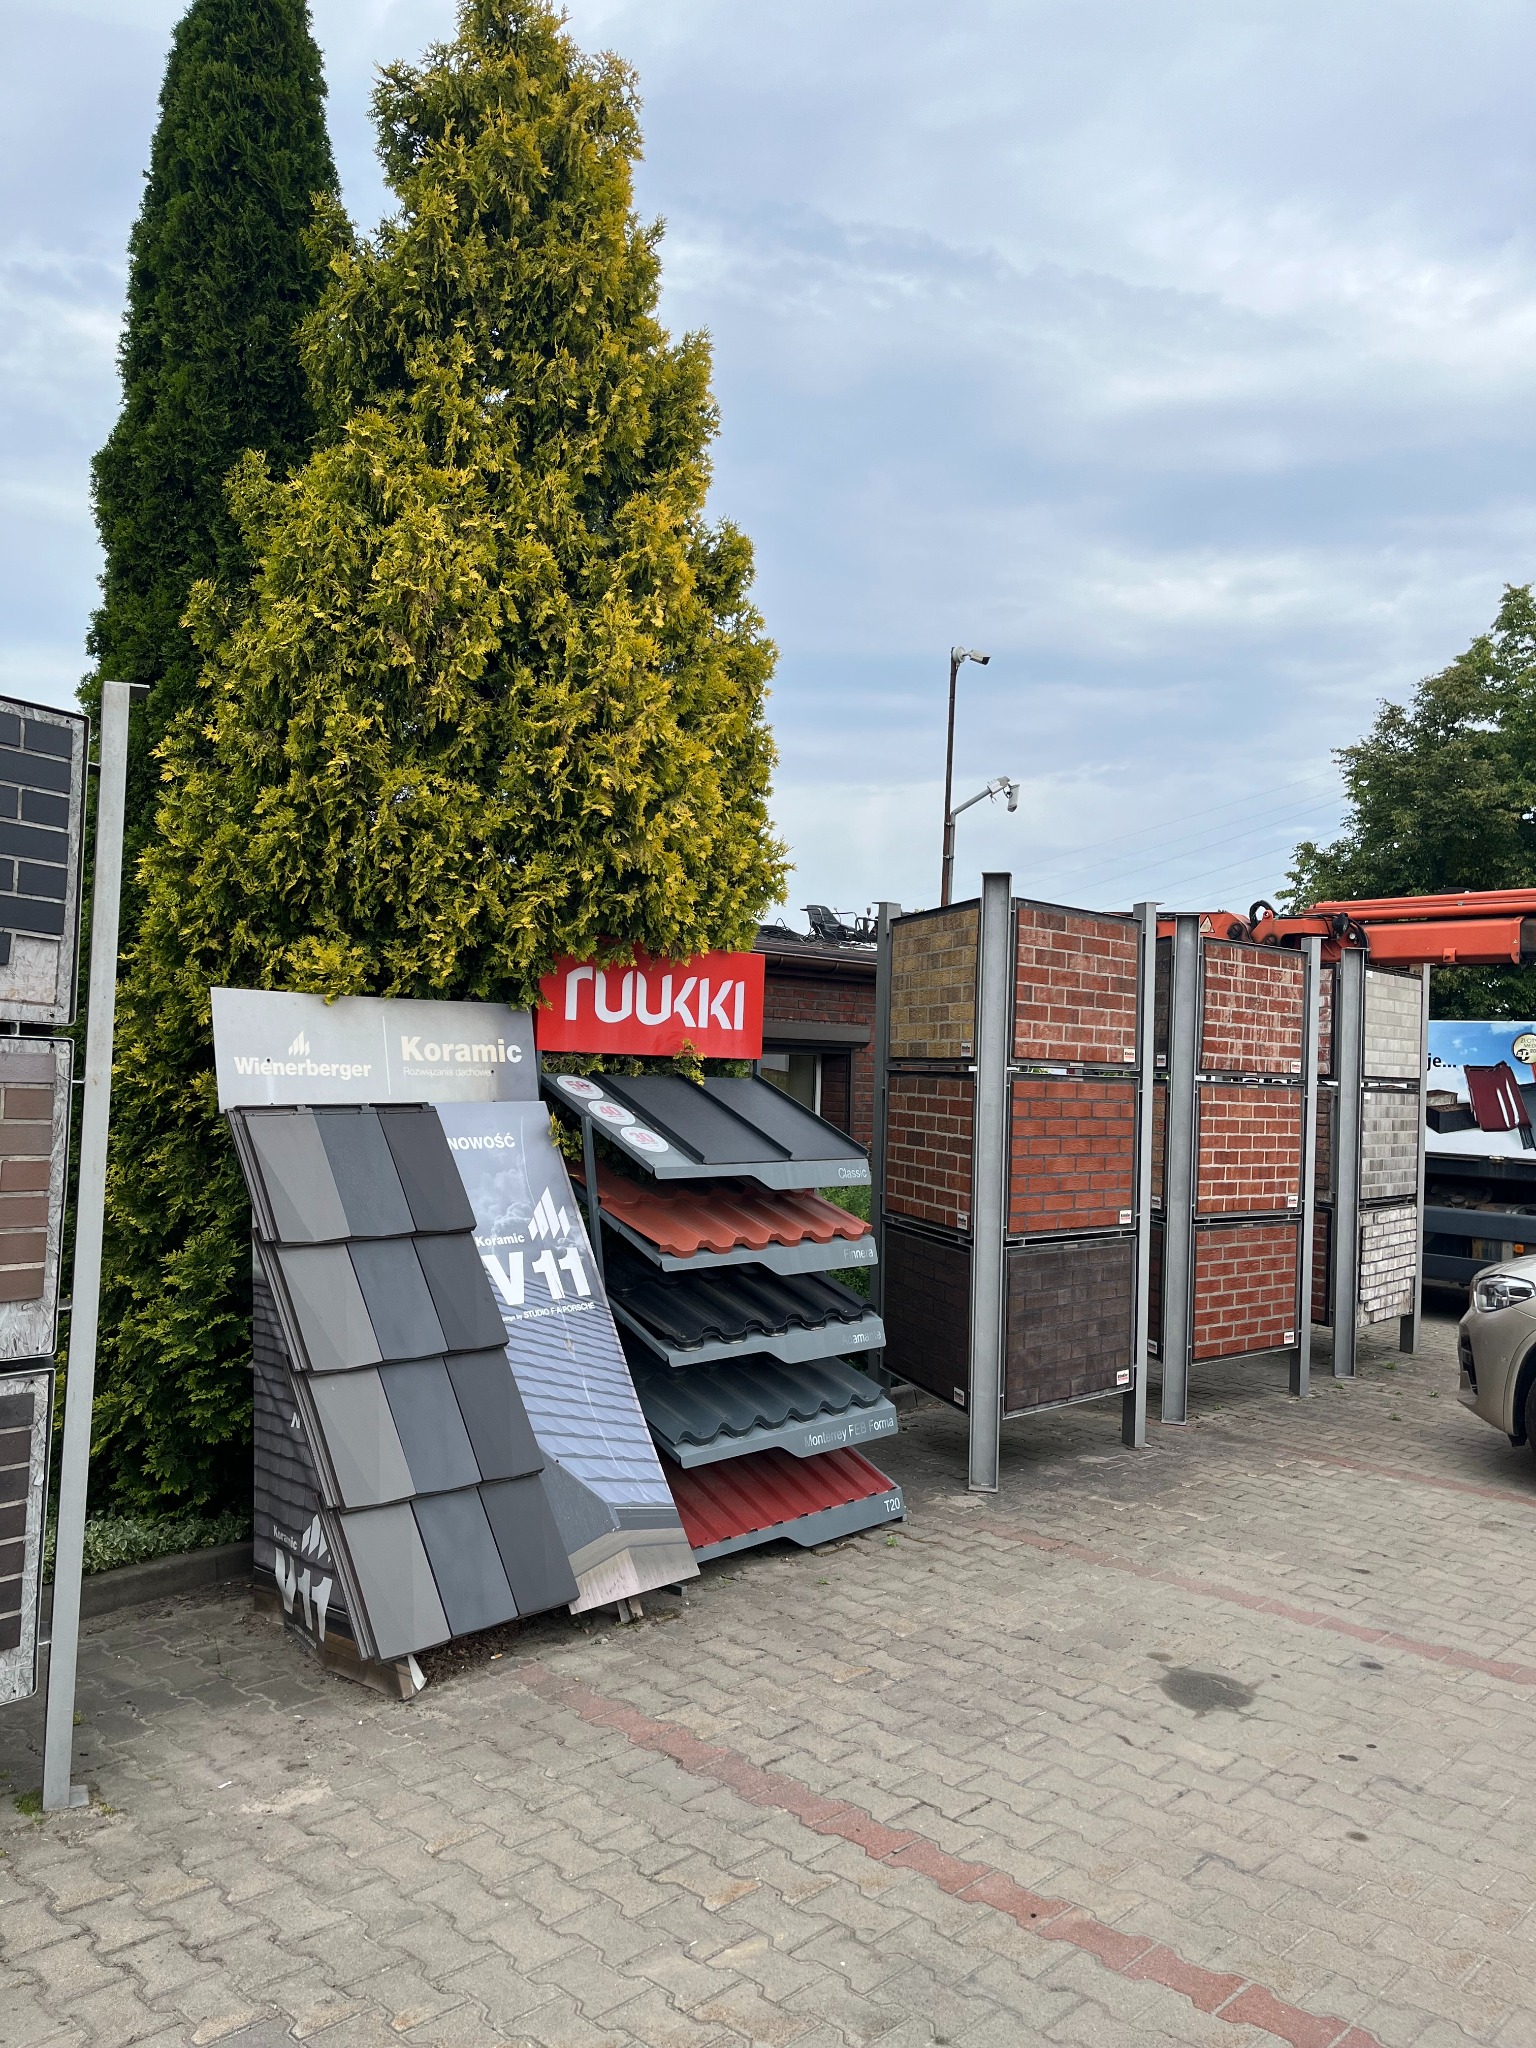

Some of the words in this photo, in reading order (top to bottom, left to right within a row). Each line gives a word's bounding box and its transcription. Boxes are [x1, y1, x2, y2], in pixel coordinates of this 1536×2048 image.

[400, 1036, 523, 1063] Koramic
[233, 1056, 372, 1080] Wienerberger
[403, 1066, 453, 1077] Rozwiązania
[455, 1067, 492, 1077] dachowe
[599, 1105, 622, 1116] 40
[446, 1132, 515, 1150] NOWOŚĆ
[629, 1132, 656, 1143] 30
[838, 1167, 867, 1179] Classic
[474, 1233, 525, 1247] Koramic
[523, 1308, 550, 1319] STUDIO
[868, 1417, 894, 1434] Forma
[883, 1497, 901, 1513] T20
